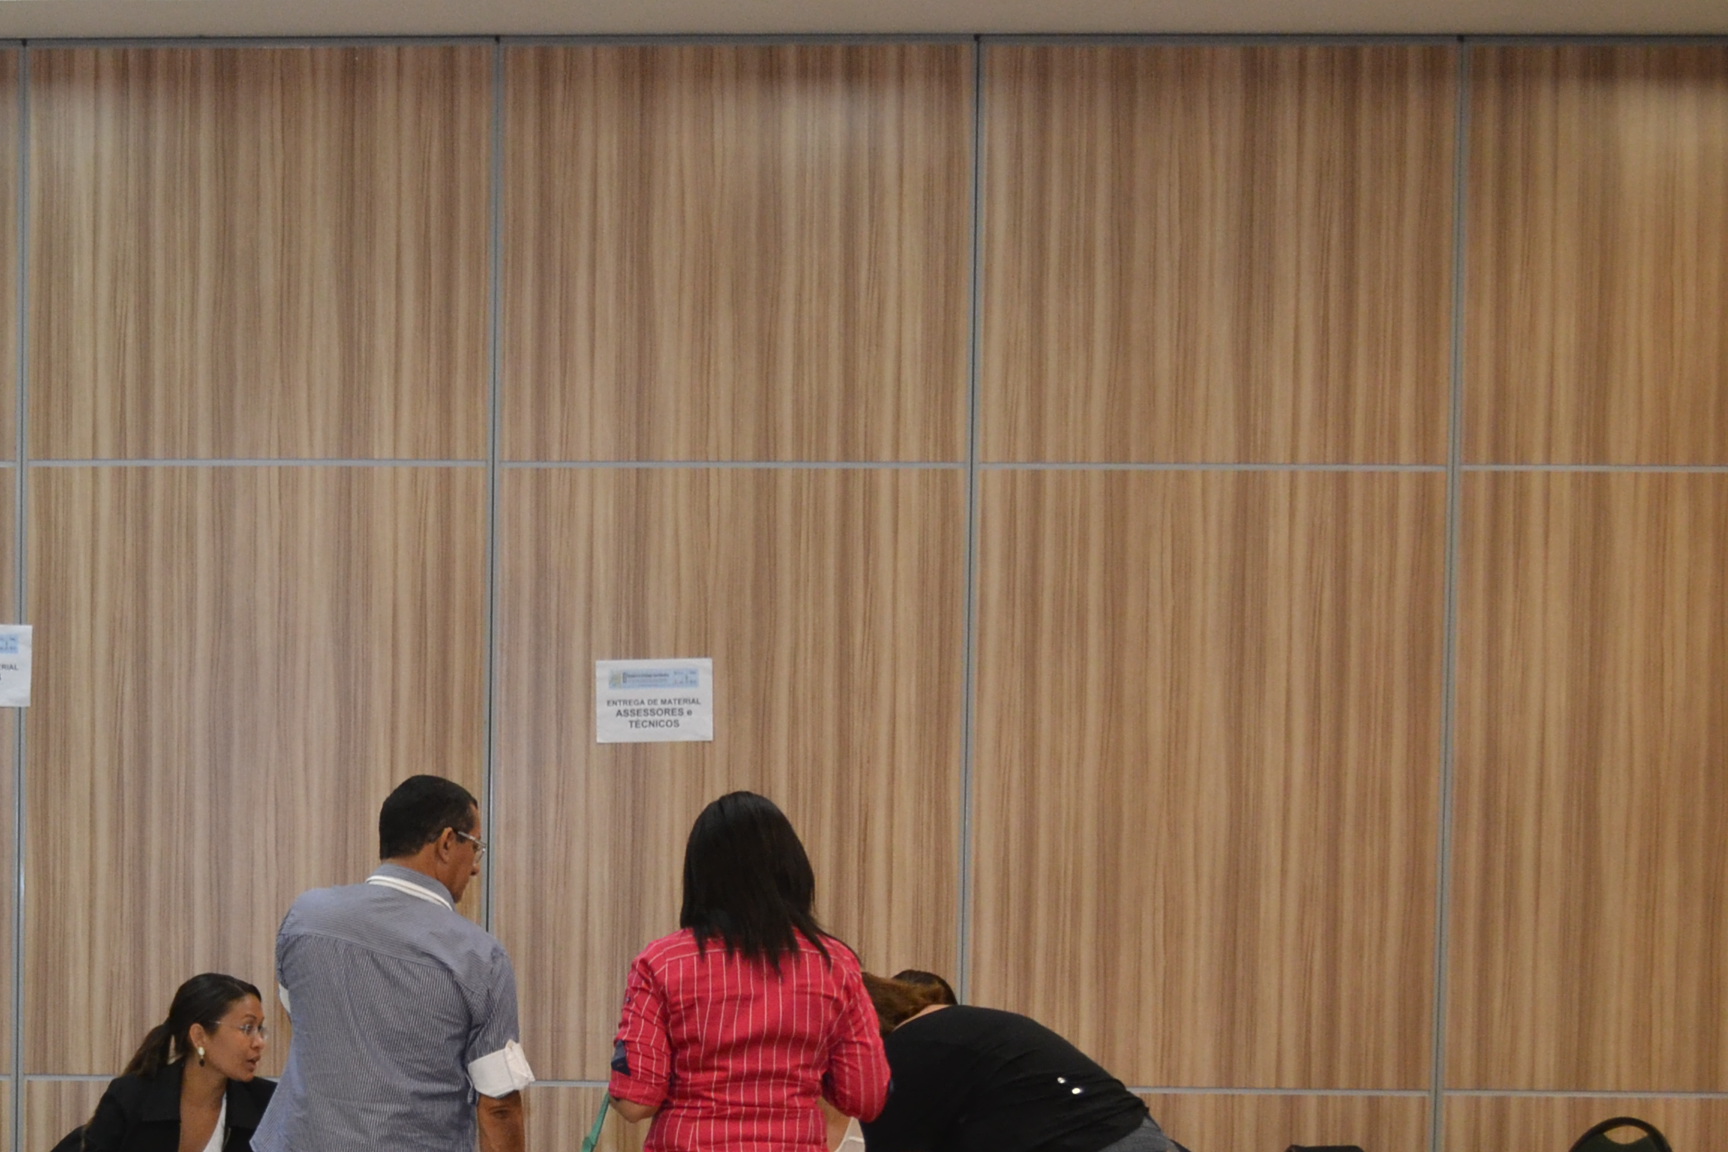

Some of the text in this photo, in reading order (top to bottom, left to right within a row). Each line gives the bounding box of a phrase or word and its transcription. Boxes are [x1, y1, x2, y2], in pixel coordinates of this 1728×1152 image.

[606, 697, 701, 707] ENTREGA DE MATERIAL
[615, 707, 684, 718] ASSESSORES
